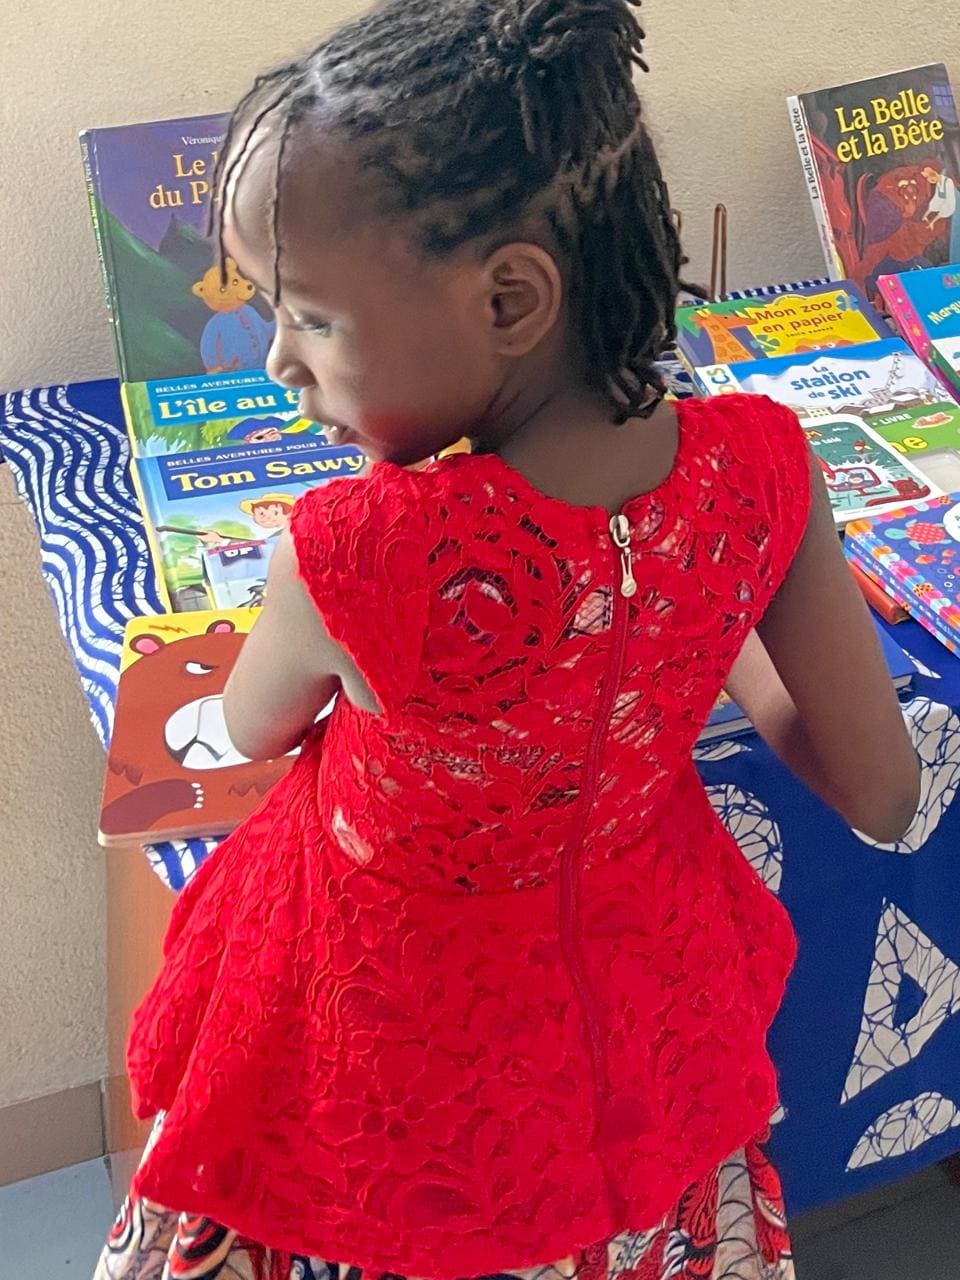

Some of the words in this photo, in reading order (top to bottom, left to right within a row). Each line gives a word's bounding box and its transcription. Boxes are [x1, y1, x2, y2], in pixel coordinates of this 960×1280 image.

[792, 107, 805, 133] Bête
[834, 105, 870, 134] La
[870, 88, 932, 121] Belle
[798, 133, 808, 145] la
[836, 135, 863, 163] et
[861, 130, 889, 158] la
[888, 118, 945, 150] Bête
[801, 146, 811, 159] et
[173, 153, 206, 177] Le
[803, 159, 817, 185] Belle
[150, 185, 184, 209] du
[810, 185, 819, 200] La
[754, 308, 797, 322] Mon
[800, 301, 833, 313] zoo
[762, 323, 785, 333] en
[789, 311, 843, 332] papier
[155, 383, 197, 394] BELLES
[201, 376, 265, 388] AVENTURES
[790, 369, 871, 391] station
[808, 390, 825, 399] de
[827, 383, 863, 400] ski
[158, 398, 227, 419] L'île
[236, 395, 275, 409] au
[283, 389, 300, 405] t
[880, 413, 913, 425] LIVRE
[167, 456, 211, 467] BELLES
[215, 447, 283, 461] AVENTURES
[286, 441, 318, 452] POUR
[170, 469, 255, 492] Tom
[265, 454, 371, 478] Sawy
